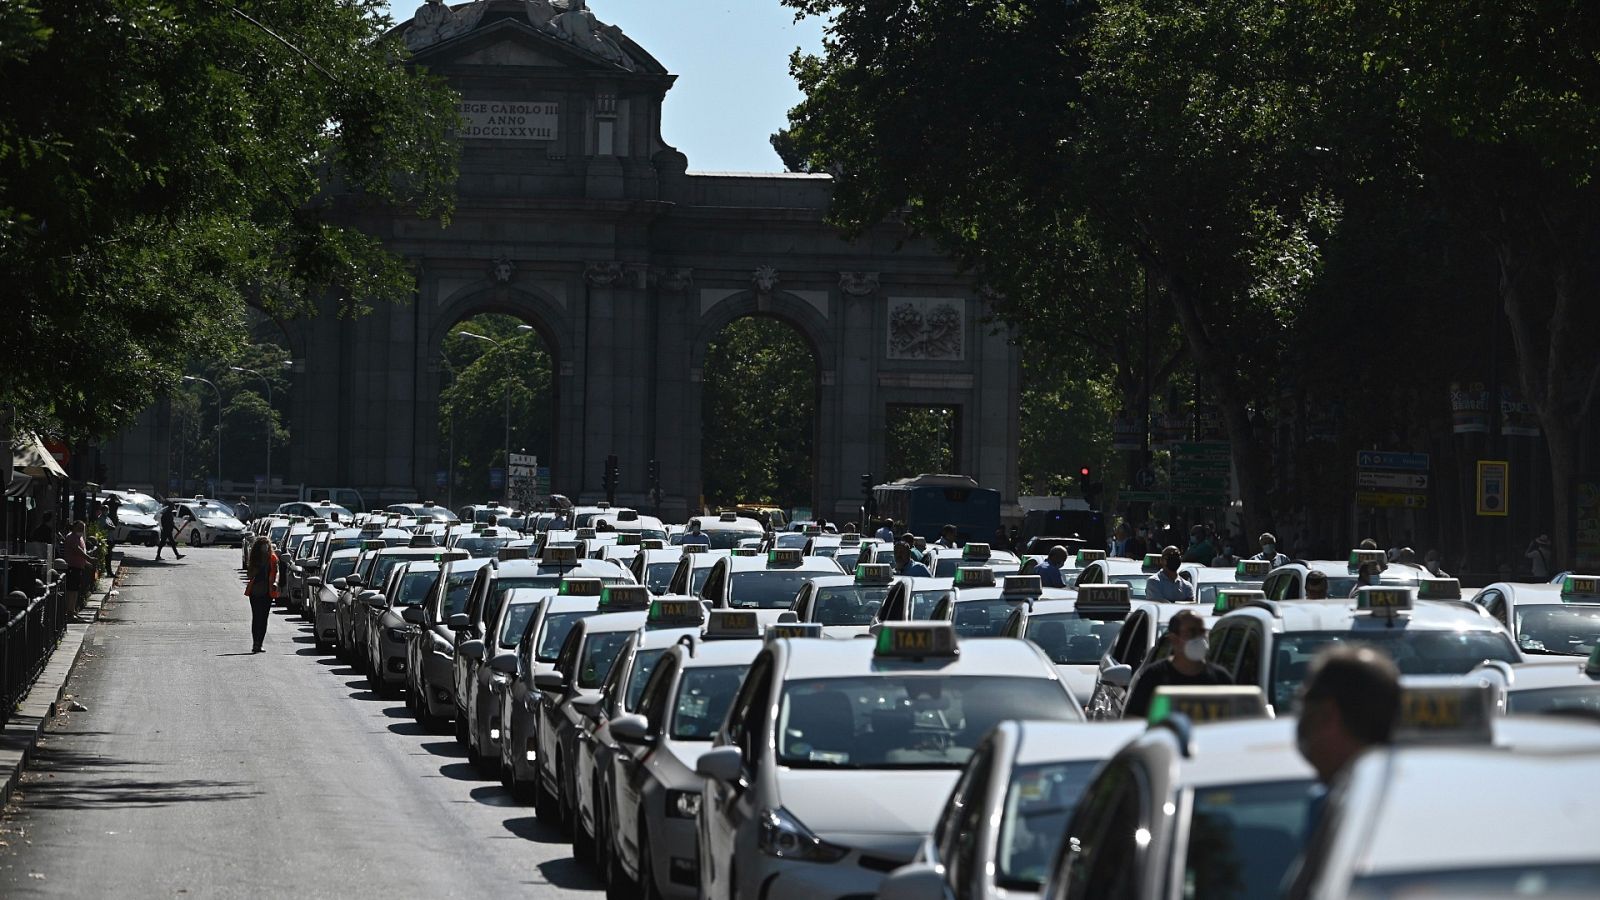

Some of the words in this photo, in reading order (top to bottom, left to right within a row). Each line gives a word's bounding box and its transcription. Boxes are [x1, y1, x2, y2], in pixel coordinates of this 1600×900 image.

[490, 104, 541, 115] CAROLO
[545, 105, 560, 115] III
[487, 116, 526, 125] ANNO
[777, 552, 792, 560] TAXI
[866, 567, 880, 576] TAXI
[965, 571, 982, 581] TAXI
[570, 583, 592, 593] TAXI
[1576, 581, 1594, 591] TAXI
[613, 590, 633, 601] TAXI
[1092, 590, 1117, 600] TAXI
[1373, 592, 1398, 606] TAXI
[662, 604, 688, 615] TAXI
[896, 630, 932, 648] TAXI
